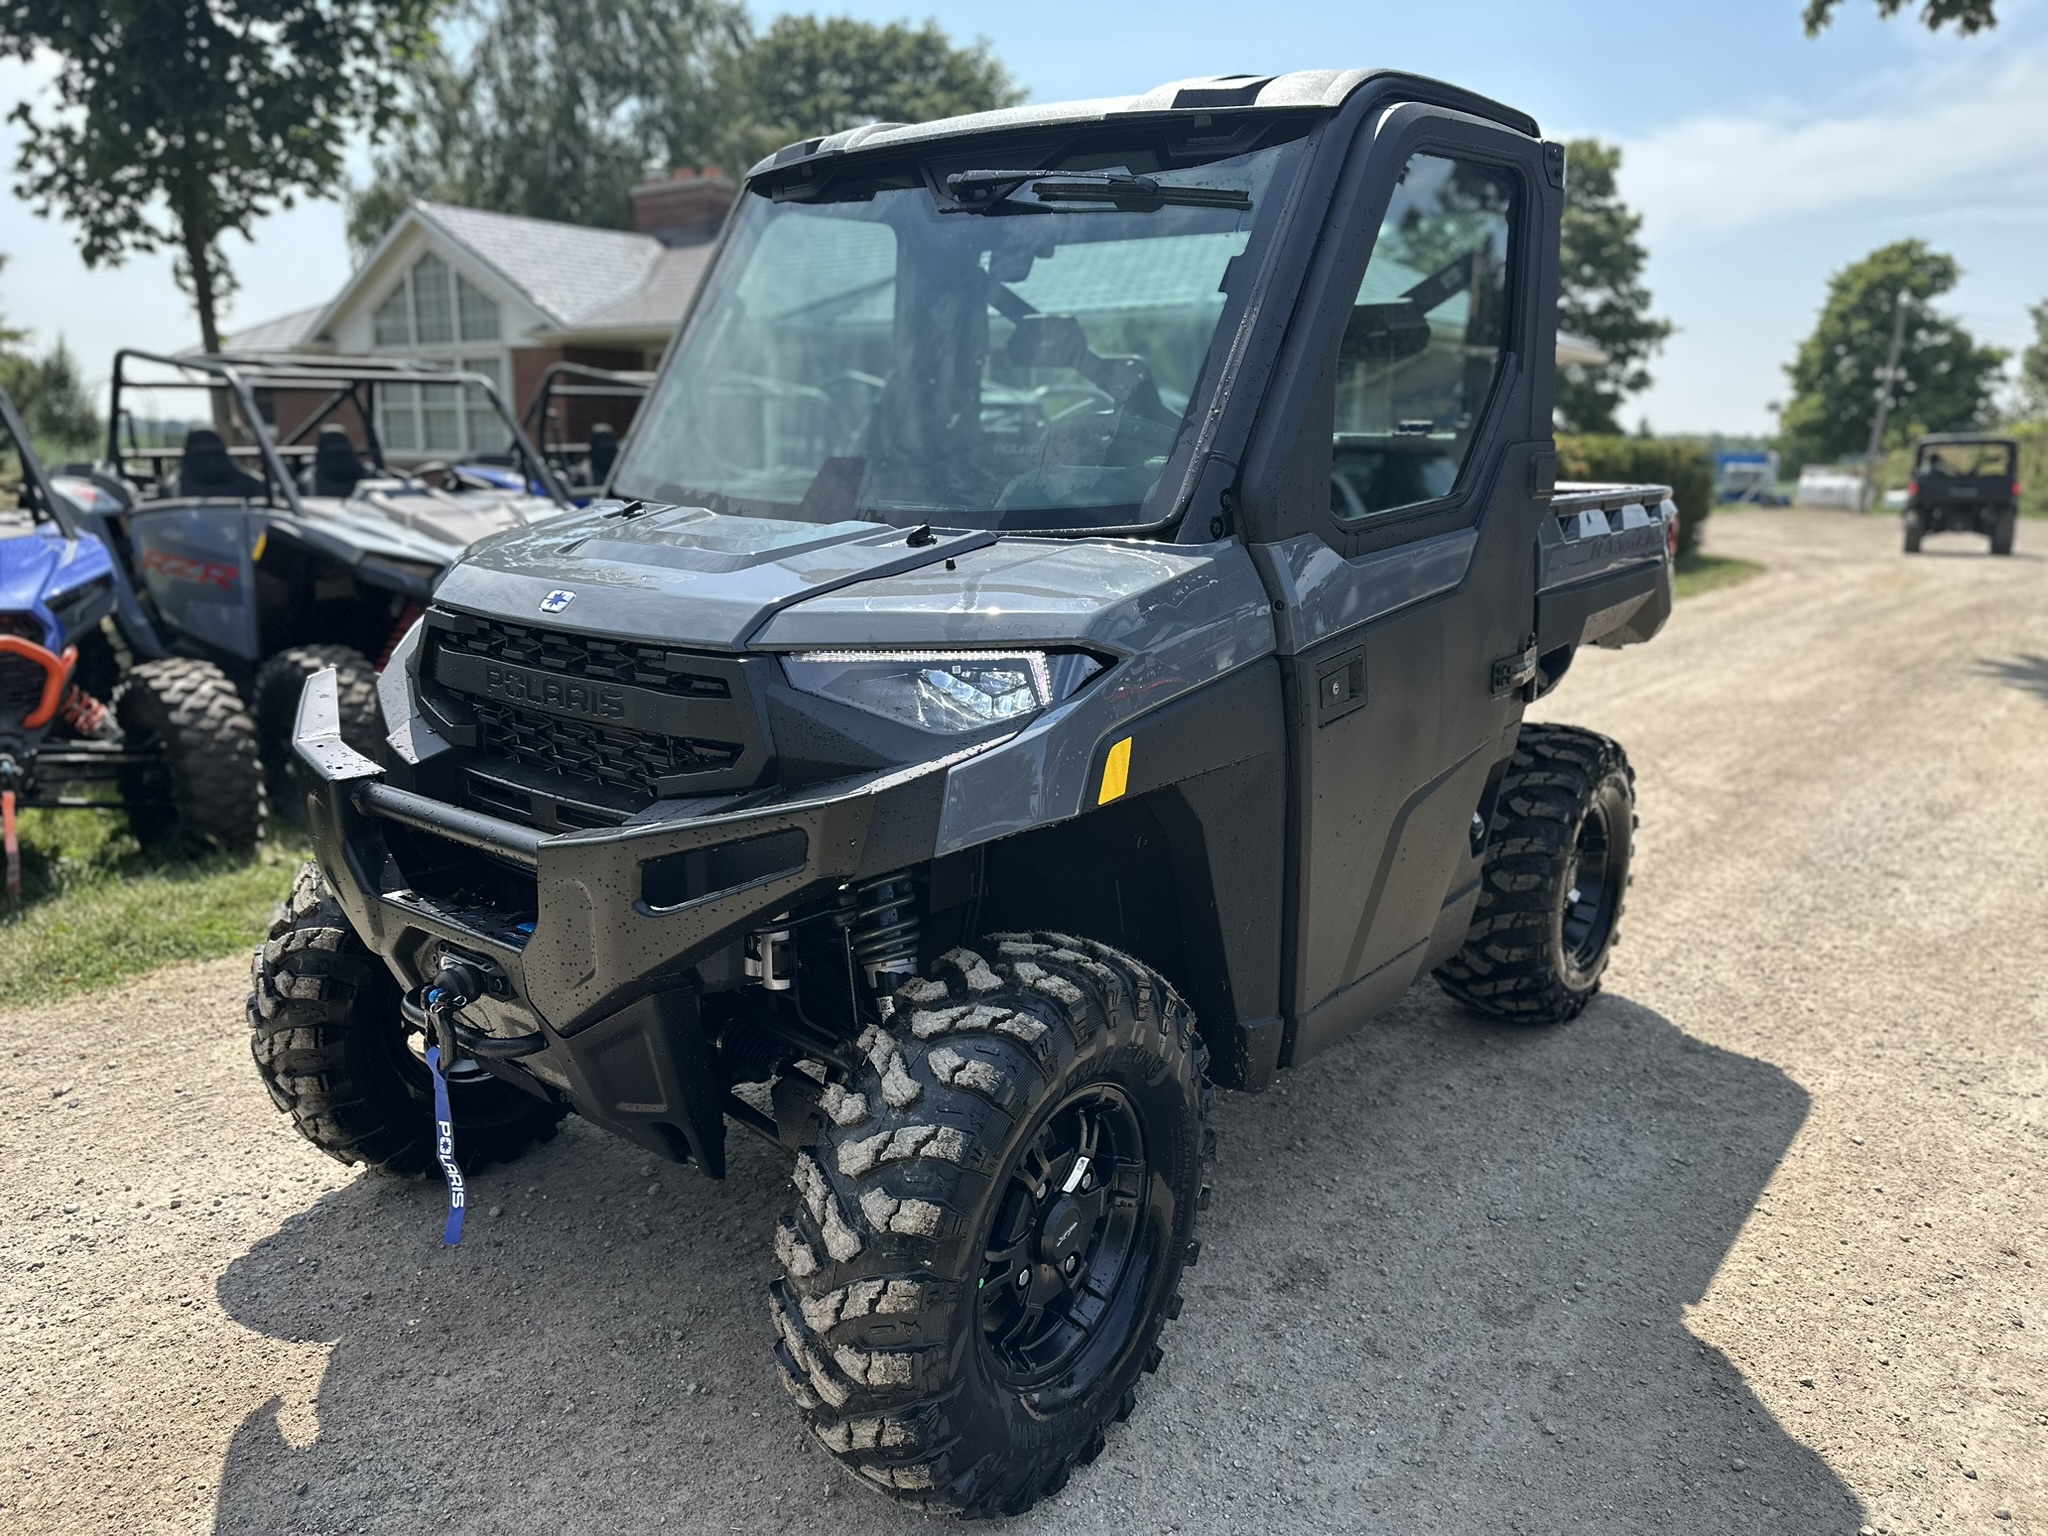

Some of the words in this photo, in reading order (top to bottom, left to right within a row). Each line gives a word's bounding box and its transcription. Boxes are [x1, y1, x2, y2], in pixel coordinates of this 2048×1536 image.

[144, 549, 239, 592] RZR
[486, 664, 625, 721] POLARIS
[438, 1120, 464, 1209] POLARIS
